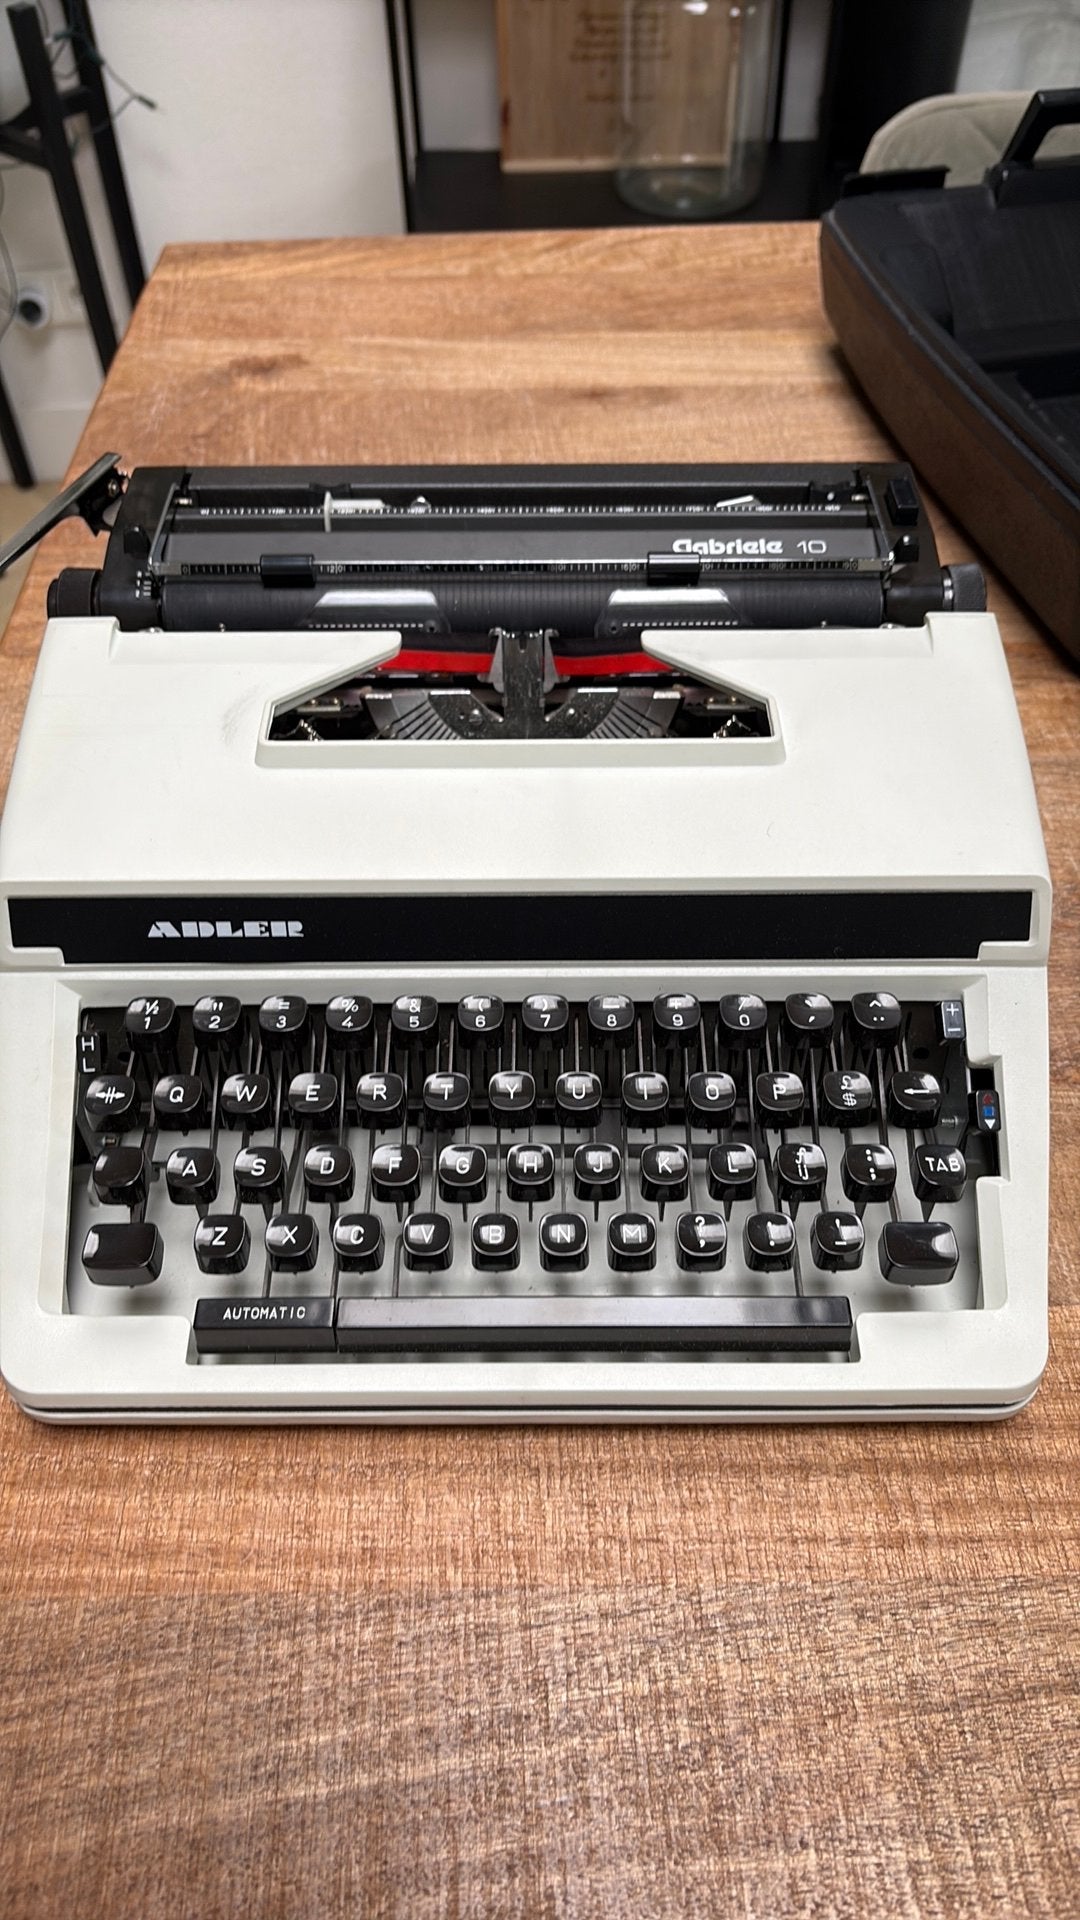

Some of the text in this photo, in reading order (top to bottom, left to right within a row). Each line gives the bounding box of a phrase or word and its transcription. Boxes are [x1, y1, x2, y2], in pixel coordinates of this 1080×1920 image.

[672, 538, 827, 555] Gabriele 10
[147, 920, 304, 938] ADLER
[144, 1016, 151, 1030] 1
[208, 1015, 221, 1029] 2
[275, 1015, 287, 1029] 3
[341, 1016, 354, 1029] 4
[409, 1015, 420, 1028] 5
[475, 1015, 486, 1028] 6
[540, 1014, 551, 1028] 7
[606, 1014, 617, 1027] 8
[672, 1014, 684, 1027] 9
[81, 1036, 95, 1052] H
[82, 1057, 96, 1073] L
[169, 1086, 184, 1103] Q
[236, 1085, 258, 1102] W
[305, 1084, 321, 1101] E
[373, 1084, 387, 1101] R
[440, 1083, 454, 1101] T
[505, 1083, 518, 1100] Y
[572, 1083, 586, 1100] U
[772, 1084, 787, 1100] P
[842, 1092, 857, 1106] $
[182, 1159, 198, 1177] A
[250, 1158, 267, 1177] S
[319, 1157, 335, 1175] D
[388, 1156, 403, 1175] F
[455, 1156, 470, 1175] G
[523, 1155, 538, 1174] H
[592, 1156, 604, 1173] J
[658, 1156, 673, 1174] K
[727, 1155, 739, 1173] L
[925, 1156, 961, 1172] TAB
[212, 1226, 228, 1245] Z
[281, 1225, 298, 1244] X
[350, 1225, 365, 1245] C
[420, 1225, 435, 1244] V
[488, 1225, 503, 1245] B
[557, 1224, 571, 1244] N
[622, 1225, 642, 1244] M
[222, 1306, 306, 1320] AUTOMATIC
